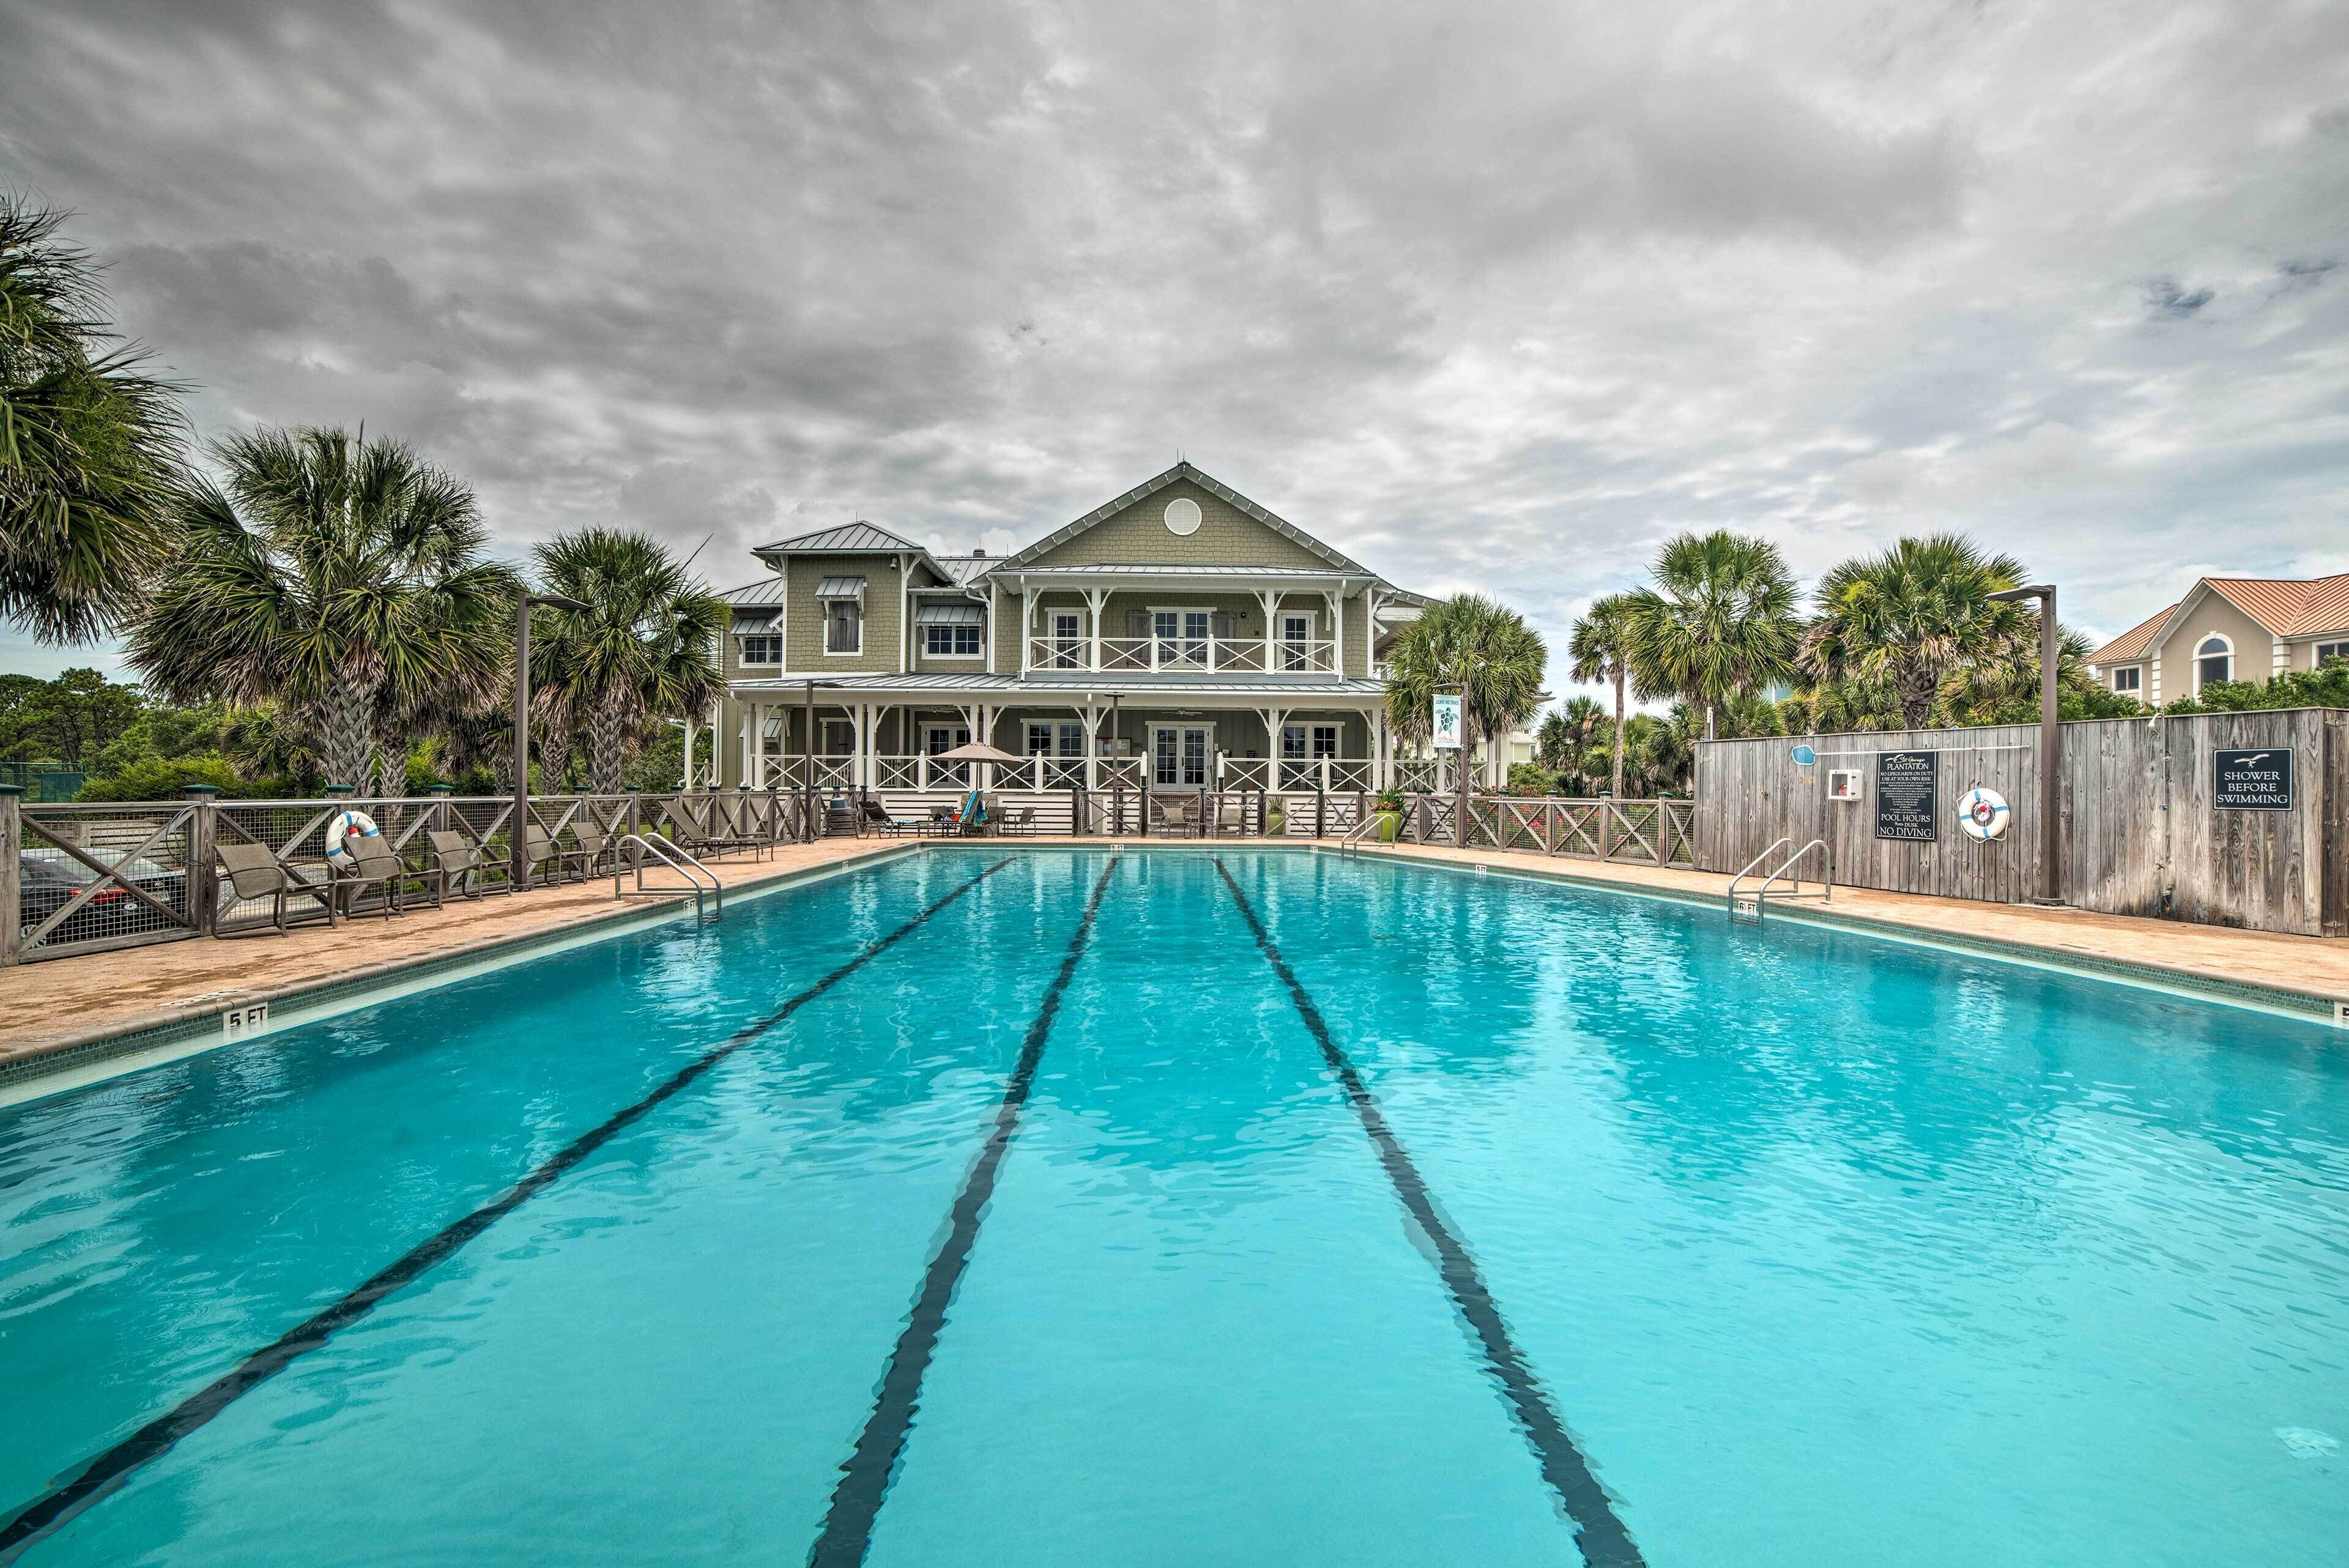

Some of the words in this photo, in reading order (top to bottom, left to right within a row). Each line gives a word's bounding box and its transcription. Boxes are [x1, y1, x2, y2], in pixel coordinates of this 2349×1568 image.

[1907, 756, 1925, 765] George
[2224, 771, 2280, 781] SHOWER
[2228, 783, 2277, 792] BEFORE
[2217, 794, 2288, 803] SWIMMING
[1880, 827, 1894, 836] NO
[1896, 827, 1932, 838] DIVING
[690, 900, 696, 908] FT
[1748, 904, 1756, 912] FT
[230, 1012, 241, 1028] 5
[248, 1006, 266, 1024] FT
